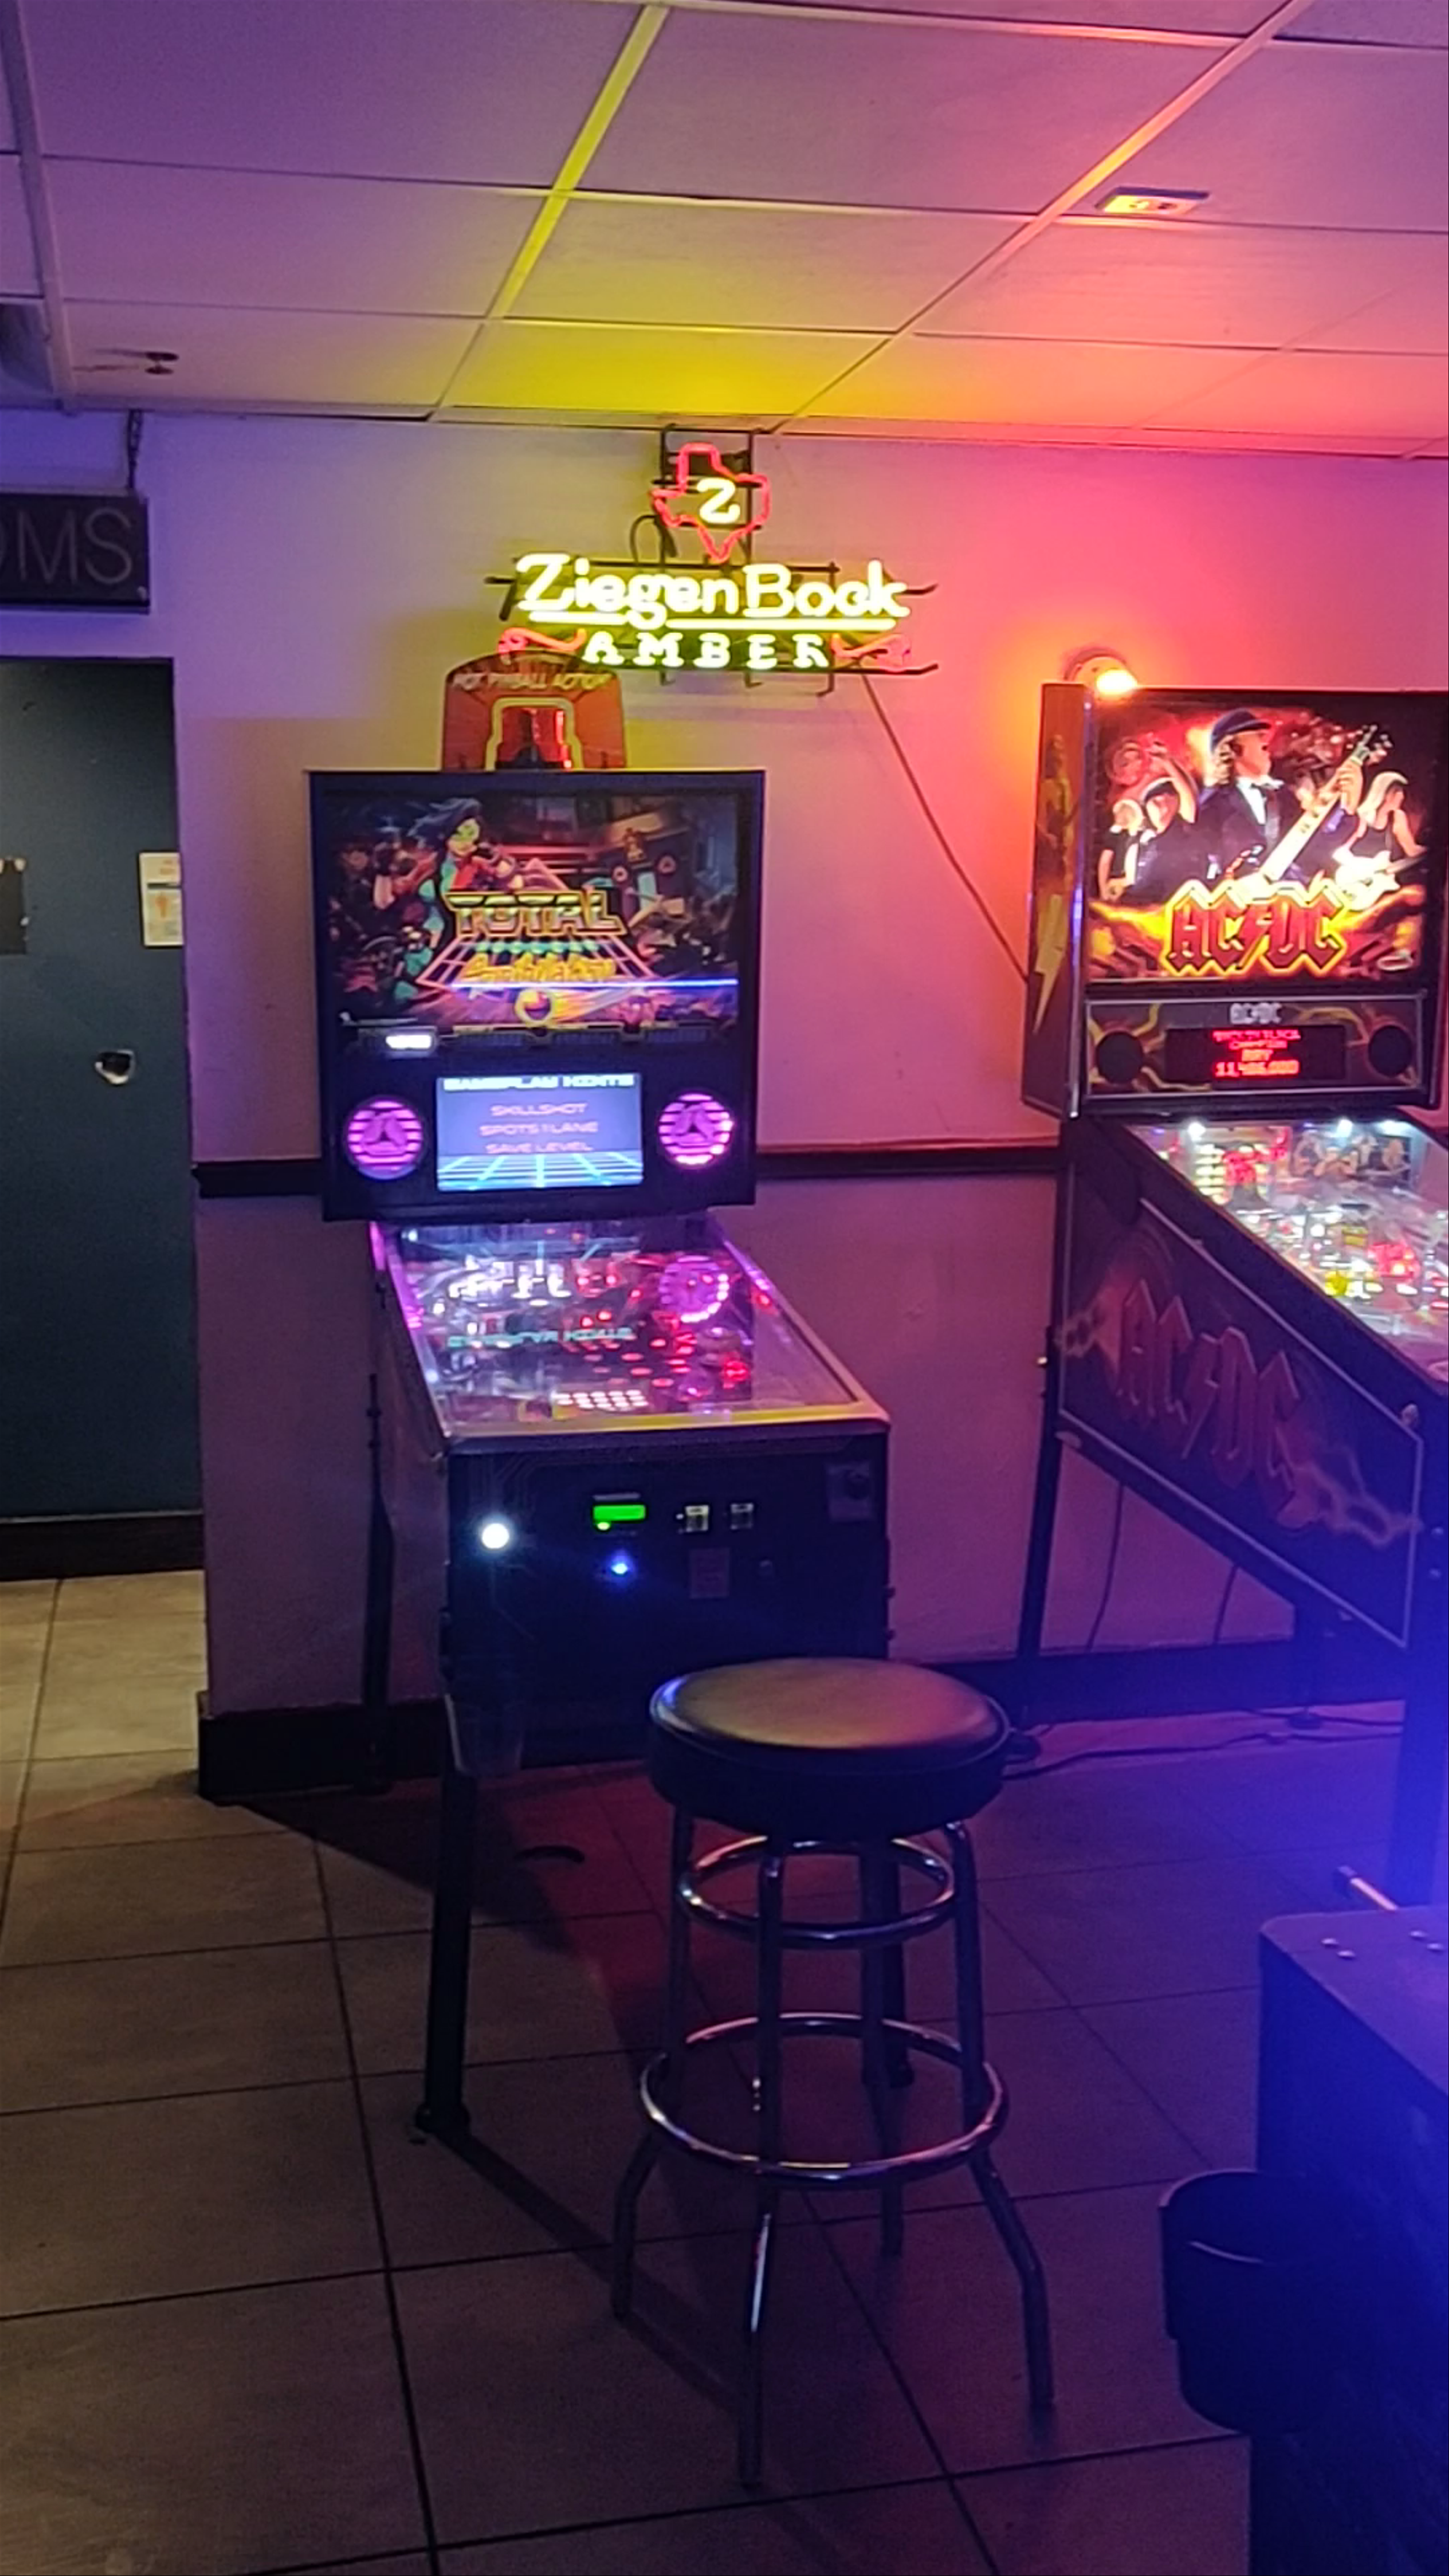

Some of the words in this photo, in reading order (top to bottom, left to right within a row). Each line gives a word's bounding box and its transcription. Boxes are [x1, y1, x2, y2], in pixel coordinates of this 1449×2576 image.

[0, 507, 132, 585] MS
[581, 631, 830, 669] AMBER
[445, 892, 623, 934] TOTAL
